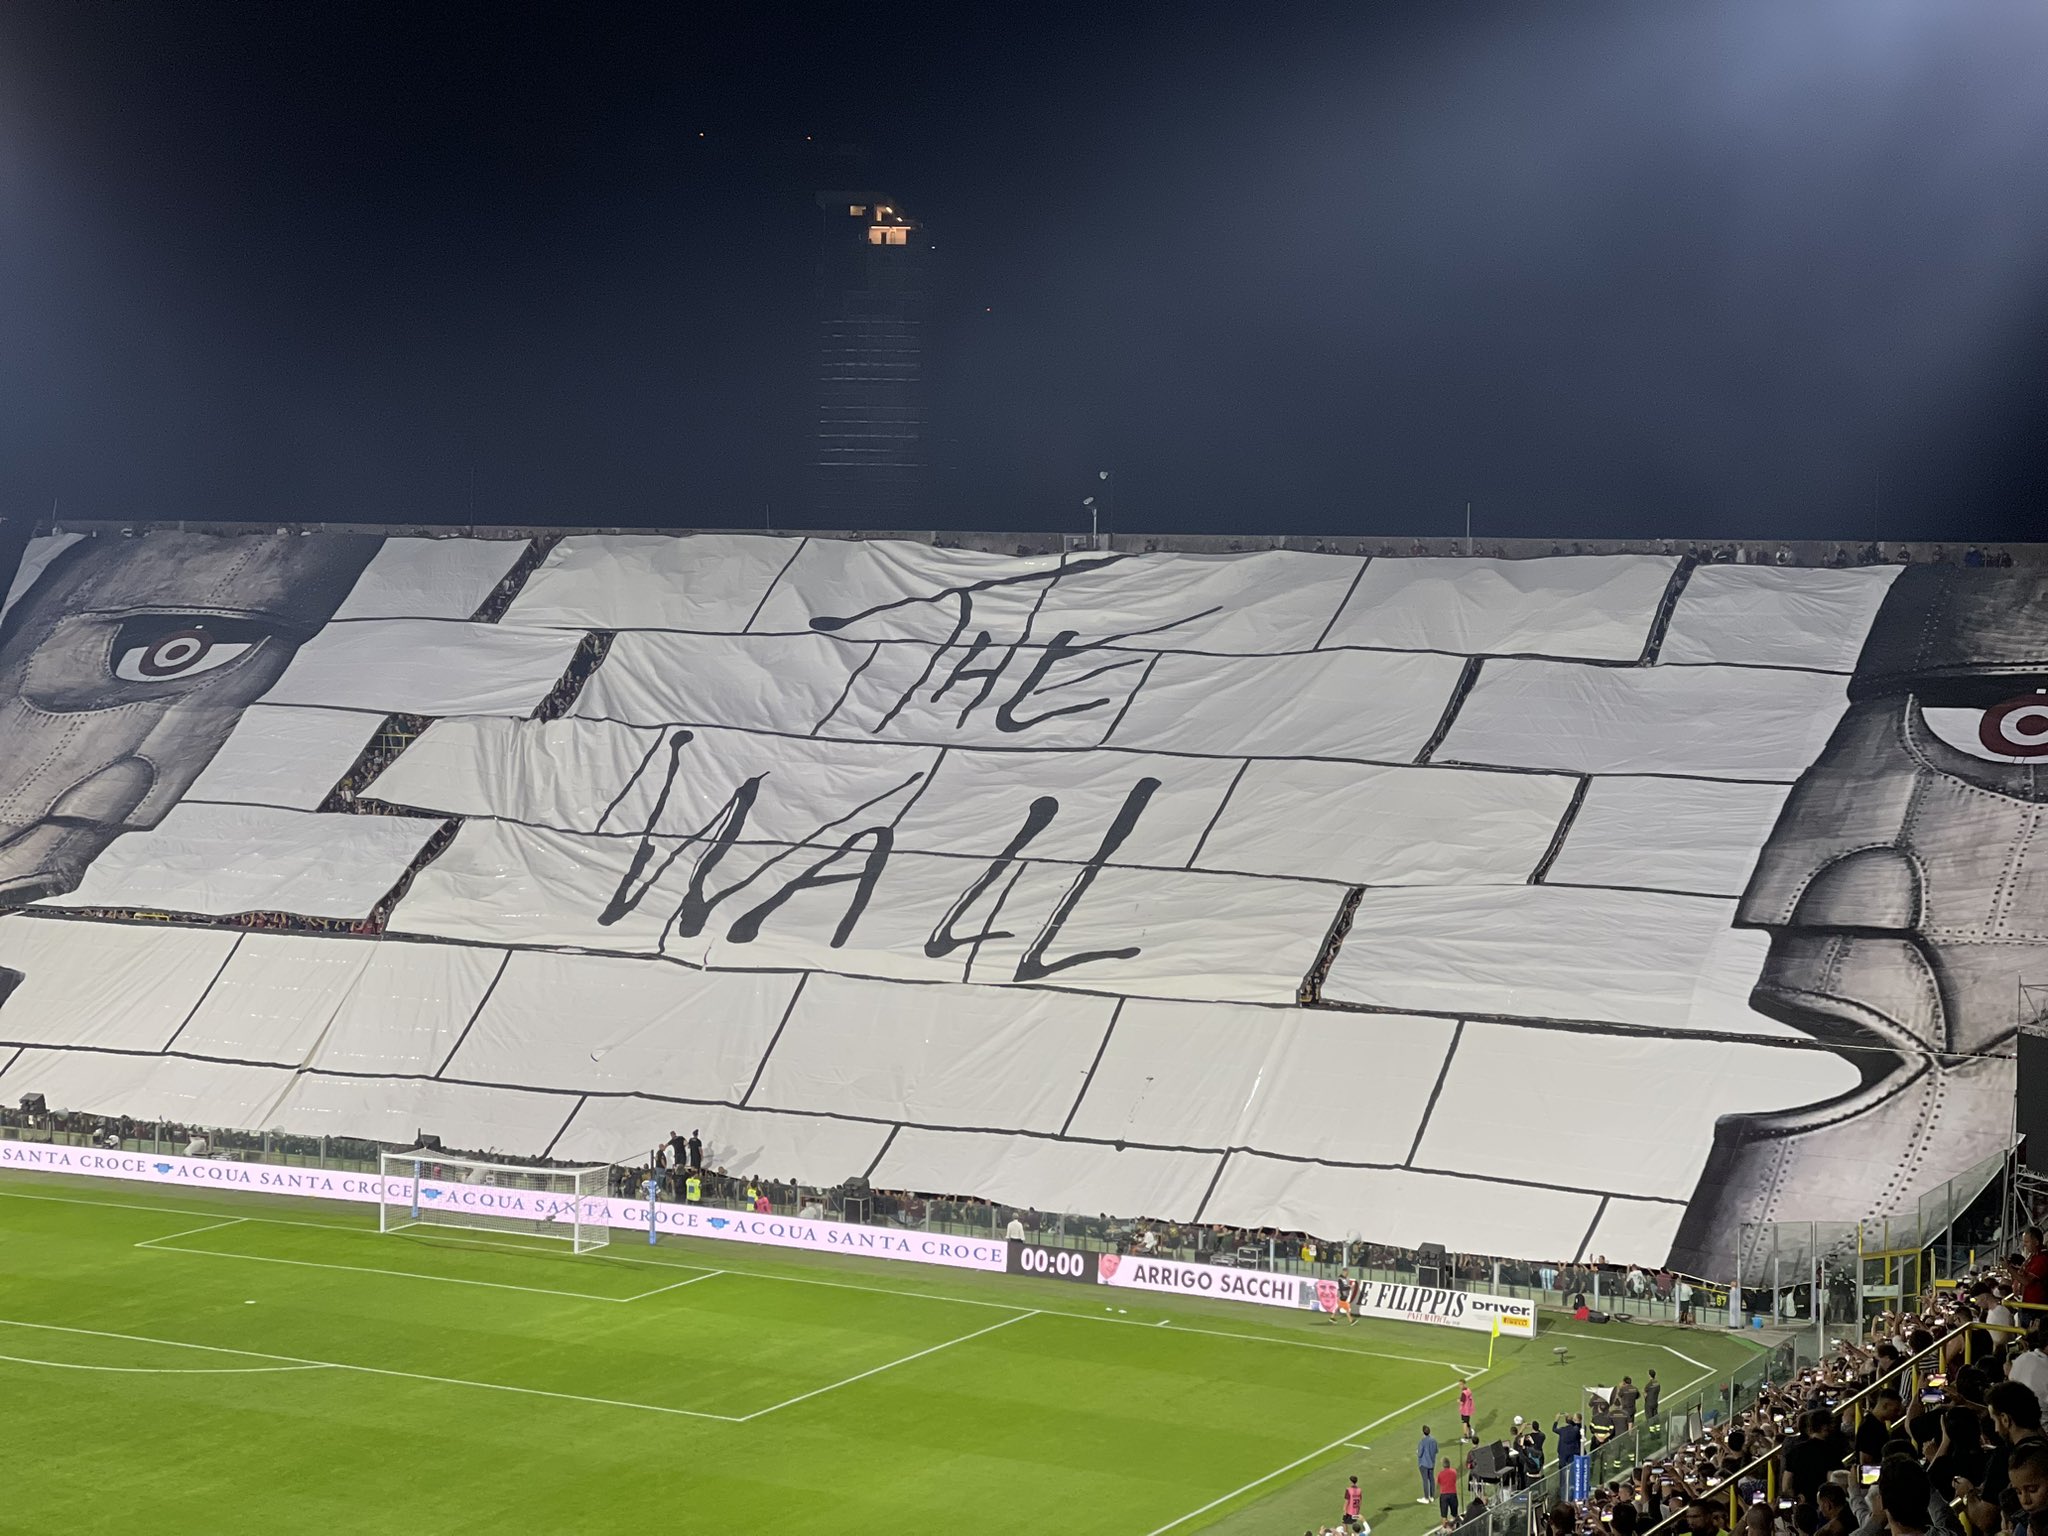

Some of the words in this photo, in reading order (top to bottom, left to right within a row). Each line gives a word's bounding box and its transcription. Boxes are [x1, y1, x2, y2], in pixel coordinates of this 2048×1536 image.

[809, 553, 1222, 733] THE
[597, 729, 1161, 982] WALL
[2, 1148, 71, 1166] SANTA
[79, 1155, 147, 1173] CROCE
[177, 1165, 251, 1183] ACQUA
[260, 1172, 334, 1191] SANTA
[342, 1179, 413, 1198] CROCE
[446, 1190, 525, 1210] ACQUA
[534, 1199, 613, 1219] SANTA
[623, 1207, 699, 1228] CROCE
[734, 1219, 817, 1242] ACQUA
[827, 1229, 912, 1253] SANTA
[921, 1240, 1003, 1263] CROCE
[1020, 1248, 1085, 1277] 00:00
[1133, 1263, 1213, 1290] ARRIGO
[1220, 1273, 1294, 1301] SACCHI
[1374, 1283, 1469, 1318] FILIPPIS
